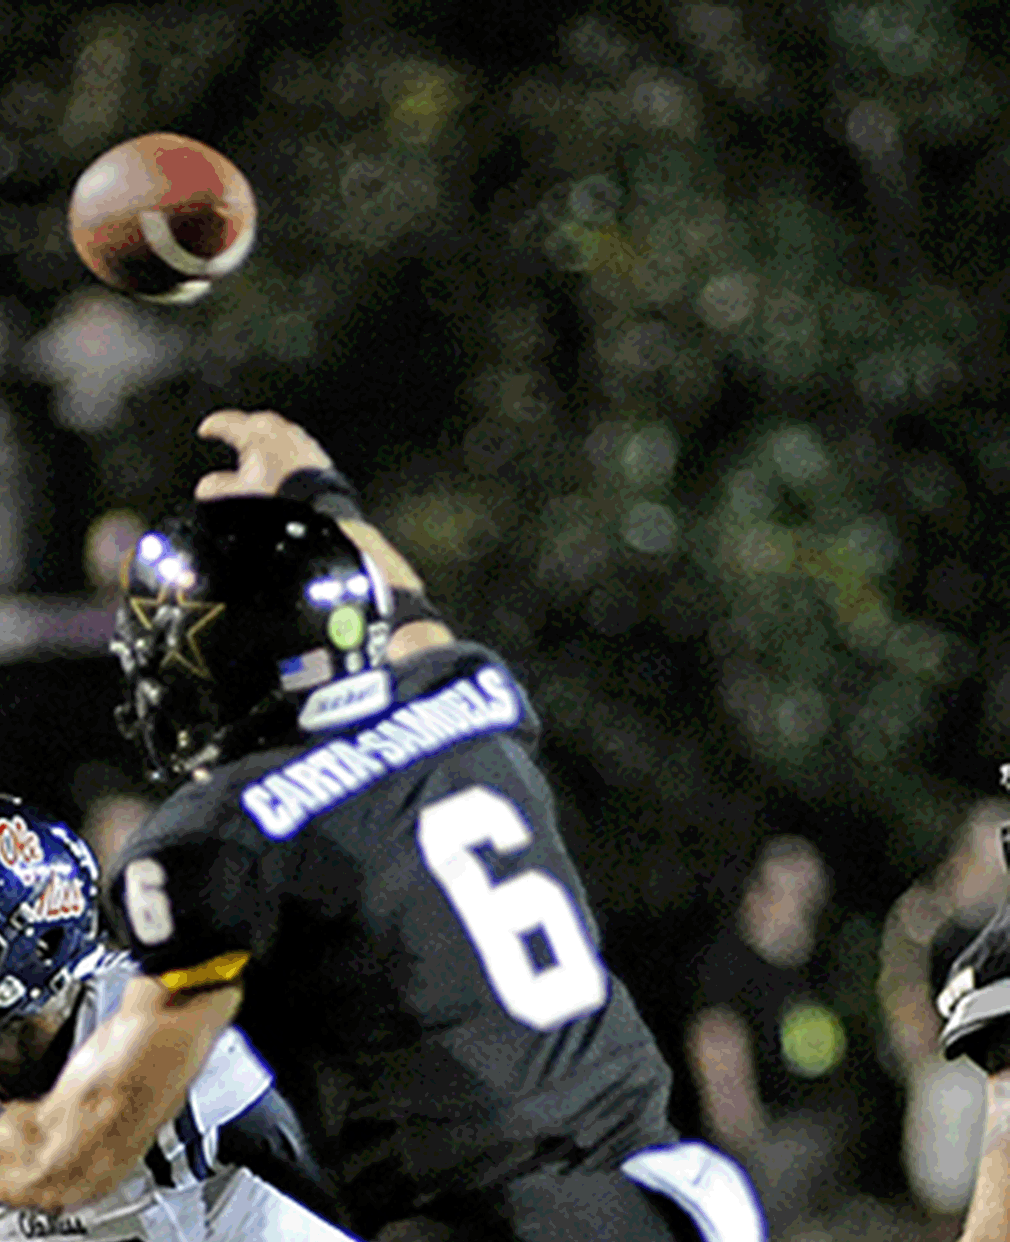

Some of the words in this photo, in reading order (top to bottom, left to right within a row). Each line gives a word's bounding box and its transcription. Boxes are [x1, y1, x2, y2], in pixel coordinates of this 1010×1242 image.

[241, 665, 520, 838] CARTA-SAMUELS
[125, 858, 174, 945] 6
[418, 783, 608, 1031] 6
